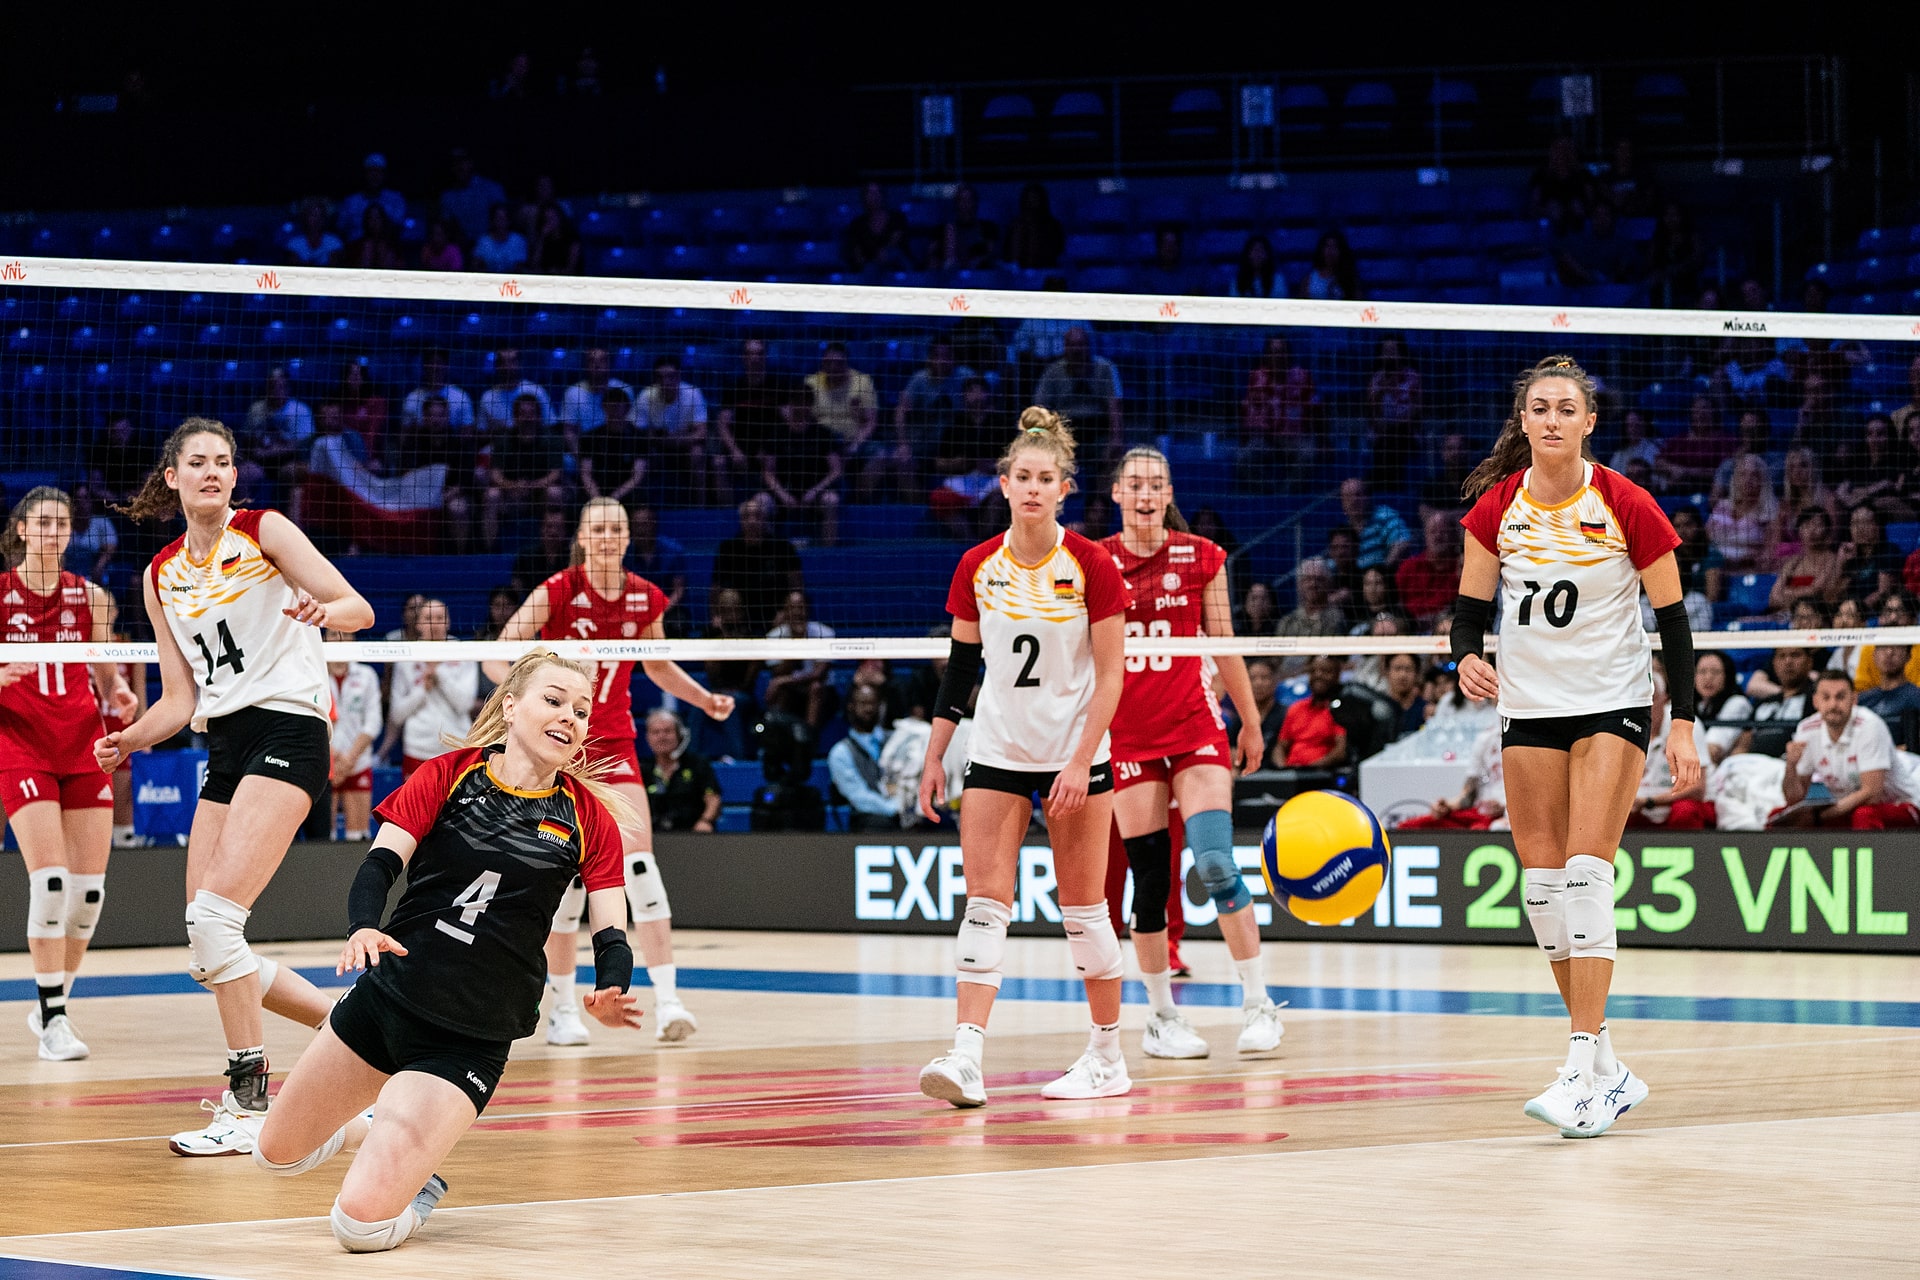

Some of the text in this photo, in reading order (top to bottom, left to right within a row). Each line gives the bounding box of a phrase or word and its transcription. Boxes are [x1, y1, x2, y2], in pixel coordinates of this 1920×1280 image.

[256, 271, 281, 289] VNL
[1507, 524, 1530, 532] mpa
[1155, 593, 1189, 611] plus
[1518, 579, 1579, 629] 10
[104, 648, 157, 657] VOLLEYBA
[192, 618, 245, 687] 14
[1012, 633, 1041, 688] 2
[600, 661, 620, 704] 7
[1622, 717, 1642, 733] Kempa
[264, 755, 290, 768] Kempa
[19, 777, 39, 799] 11
[537, 830, 567, 848] GERMANY
[452, 869, 502, 927] 4
[1721, 847, 1908, 935] VNL
[466, 1069, 488, 1094] Kempa
